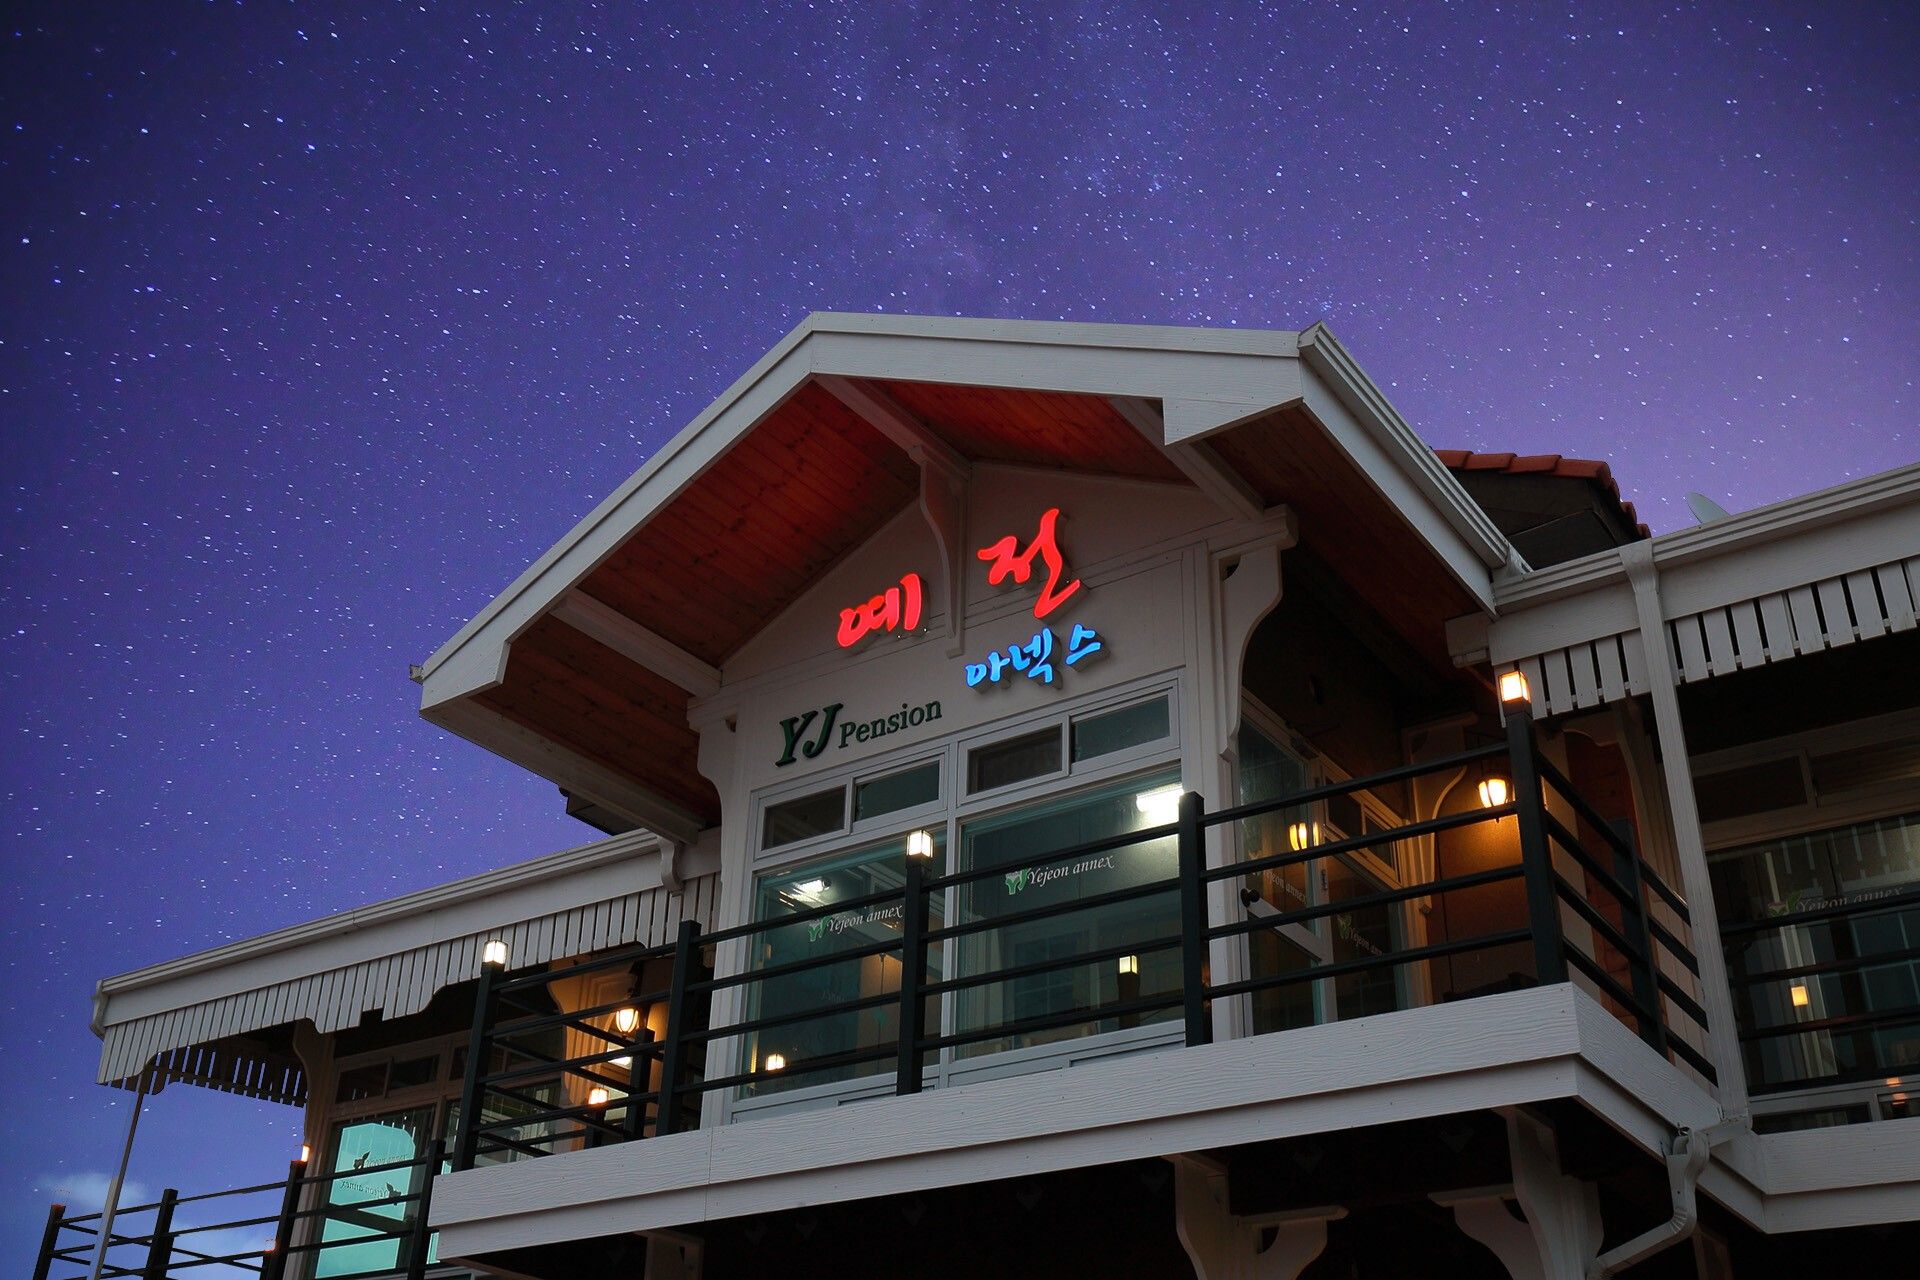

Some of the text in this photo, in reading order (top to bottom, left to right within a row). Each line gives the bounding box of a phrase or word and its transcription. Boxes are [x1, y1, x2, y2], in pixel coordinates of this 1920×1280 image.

[775, 700, 943, 768] YJ Pension
[1027, 855, 1115, 888] Yejeon annex
[826, 904, 903, 935] Yejeon annex
